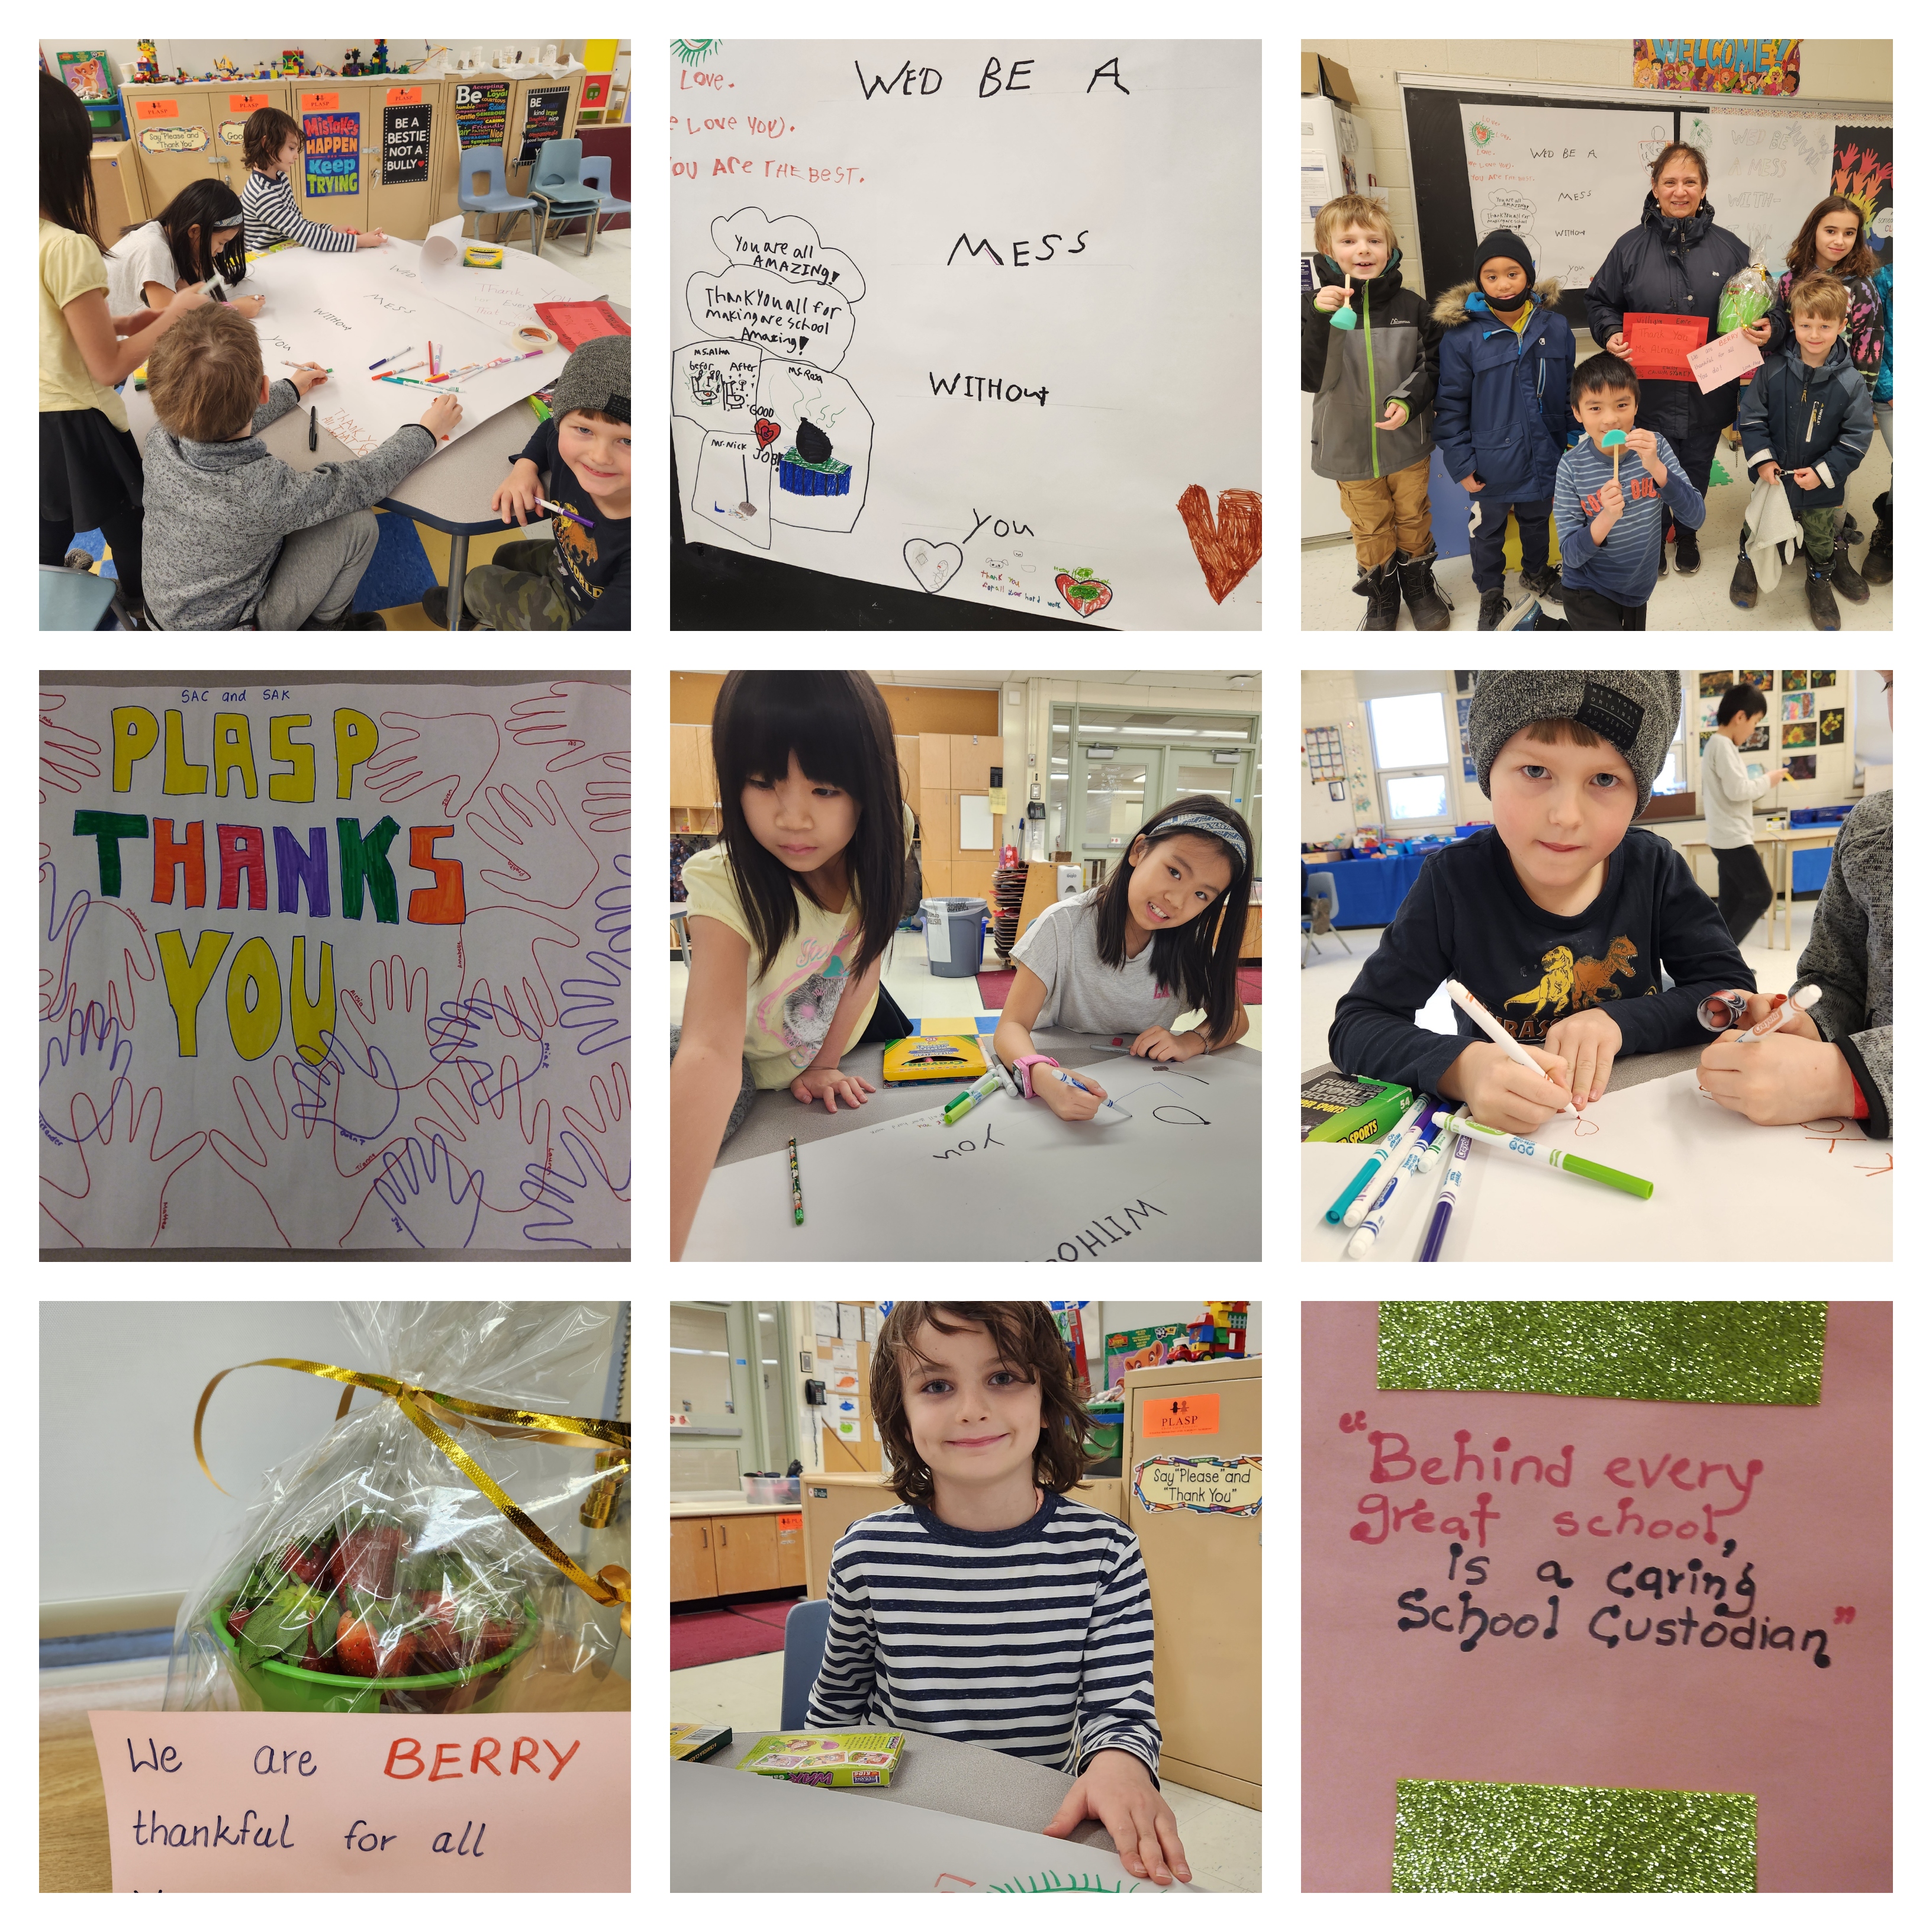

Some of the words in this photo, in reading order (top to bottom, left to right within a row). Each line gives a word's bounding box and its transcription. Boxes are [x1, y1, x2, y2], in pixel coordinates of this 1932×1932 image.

[1650, 39, 1792, 73] WELCOME!
[979, 57, 1035, 97] BE
[1087, 57, 1130, 95] A
[456, 86, 482, 104] Be
[530, 98, 542, 108] BE
[395, 118, 409, 129] BE
[411, 117, 420, 127] A
[150, 133, 161, 141] Say
[388, 130, 427, 144] BESTIE
[490, 129, 503, 138] Nice
[529, 130, 558, 138] compassionate
[1769, 130, 1791, 150] BE
[307, 137, 358, 154] HAPPEN
[389, 146, 413, 157] NOT
[414, 145, 423, 154] A
[1563, 148, 1576, 159] BE
[1588, 149, 1598, 159] A
[387, 159, 418, 171] BULLY
[765, 160, 806, 180] THE
[1728, 157, 1742, 176] A
[1747, 158, 1787, 178] MESS
[307, 172, 358, 194] TRYING
[1558, 189, 1592, 202] MESS
[735, 234, 760, 253] You
[764, 242, 788, 255] are
[793, 245, 813, 259] all
[948, 230, 1089, 266] MESS
[475, 283, 524, 296] Thank
[364, 294, 416, 314] MESS
[474, 306, 500, 315] That
[757, 289, 783, 310] You
[786, 297, 807, 314] all
[813, 301, 842, 319] for
[706, 308, 758, 326] making
[761, 314, 783, 327] are
[787, 318, 829, 334] school
[1638, 328, 1664, 339] Thank
[1673, 330, 1688, 342] You
[1718, 332, 1739, 347] BERRY
[1635, 345, 1646, 353] Ms.
[729, 362, 758, 372] After
[1694, 357, 1714, 370] thankful
[804, 369, 823, 384] Rosa
[749, 404, 774, 418] GOOD
[181, 689, 209, 703] SAC
[222, 689, 246, 702] and
[262, 689, 291, 700] SAK
[1592, 688, 1612, 699] NEW
[1618, 697, 1638, 715] YORK
[1591, 697, 1635, 724] ORIGINAL
[1588, 709, 1632, 735] AUTHENTIC
[111, 706, 379, 803] PLASP
[73, 810, 466, 925] THANKS
[155, 928, 337, 1067] YOU
[1753, 1010, 1780, 1034] Crayola
[1320, 1078, 1388, 1094] GUINNESS
[1301, 1090, 1367, 1107] RECORDS
[1400, 1096, 1411, 1110] 54
[1313, 1102, 1350, 1113] SPORTS
[1349, 1119, 1378, 1144] SPORTS
[1457, 1134, 1471, 1158] Crayola
[1162, 1415, 1198, 1427] PLASP
[1154, 1469, 1175, 1486] Say
[1225, 1469, 1251, 1483] and
[1604, 1453, 1764, 1518] every
[1350, 1492, 1501, 1547] great
[1450, 1543, 1489, 1586] is
[1537, 1559, 1573, 1589] a
[1606, 1557, 1756, 1618] caring
[1397, 1588, 1560, 1652] School
[127, 1737, 182, 1773] We
[253, 1745, 318, 1776] are
[384, 1736, 580, 1782] BERRY
[133, 1809, 295, 1849] thankful
[344, 1820, 397, 1853] for
[432, 1821, 487, 1857] all
